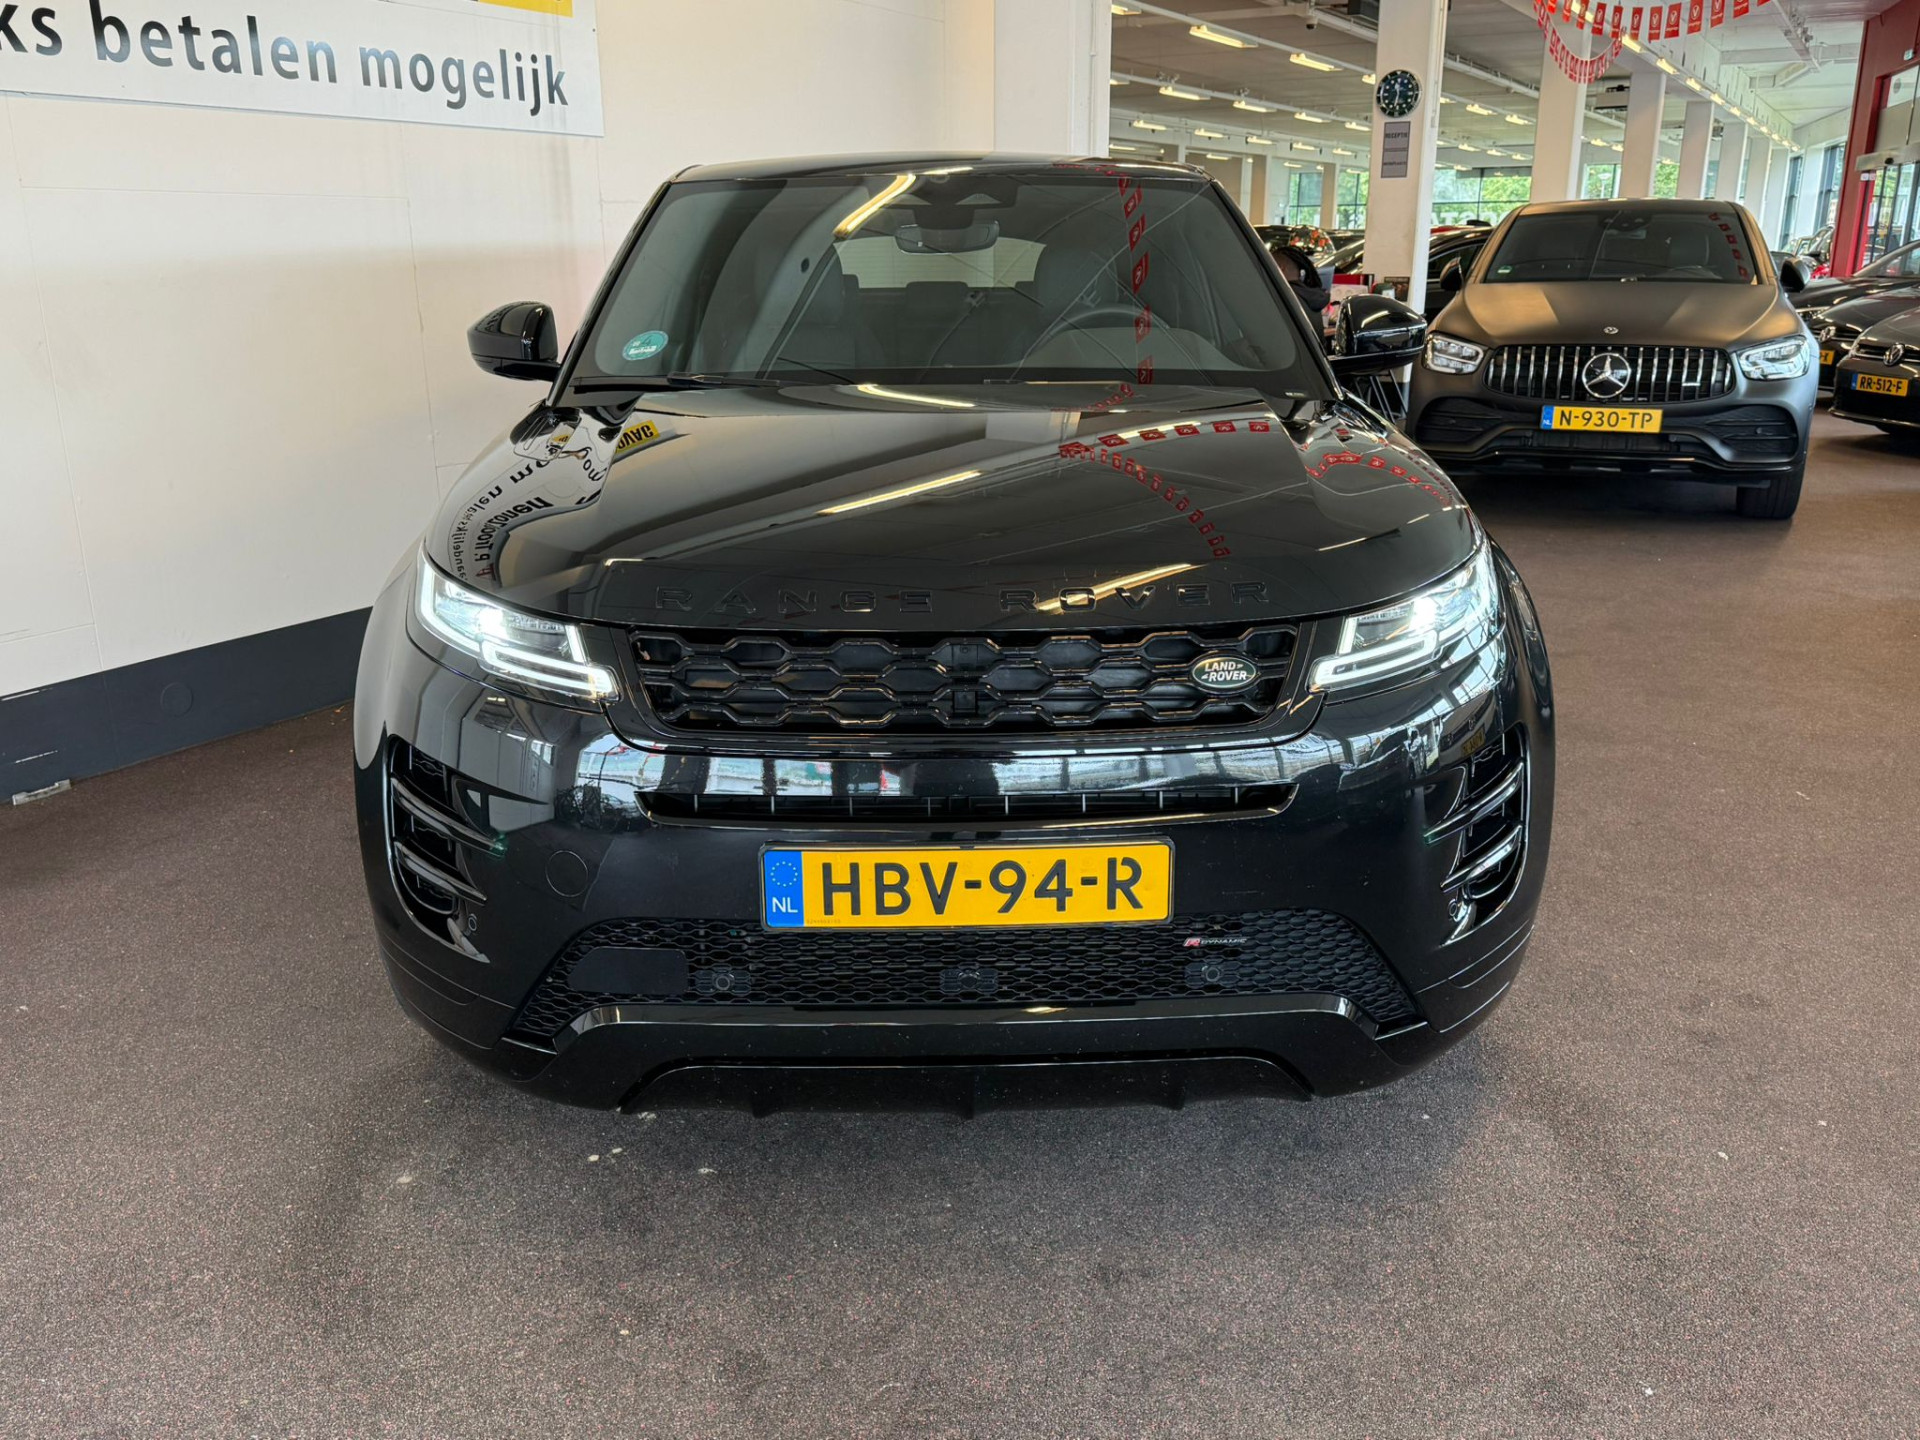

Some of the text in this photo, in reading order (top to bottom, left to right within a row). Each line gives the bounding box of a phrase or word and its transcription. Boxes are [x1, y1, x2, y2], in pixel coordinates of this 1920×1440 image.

[89, 0, 337, 84] betalen
[359, 46, 569, 117] mogelijk
[1859, 376, 1903, 393] RR-512-F
[1559, 410, 1653, 429] N-930-TP
[655, 581, 1270, 614] RANGE ROVER
[1205, 661, 1236, 672] LAND
[1208, 670, 1248, 682] ROVER
[772, 857, 1144, 916] NL HBV-94-R
